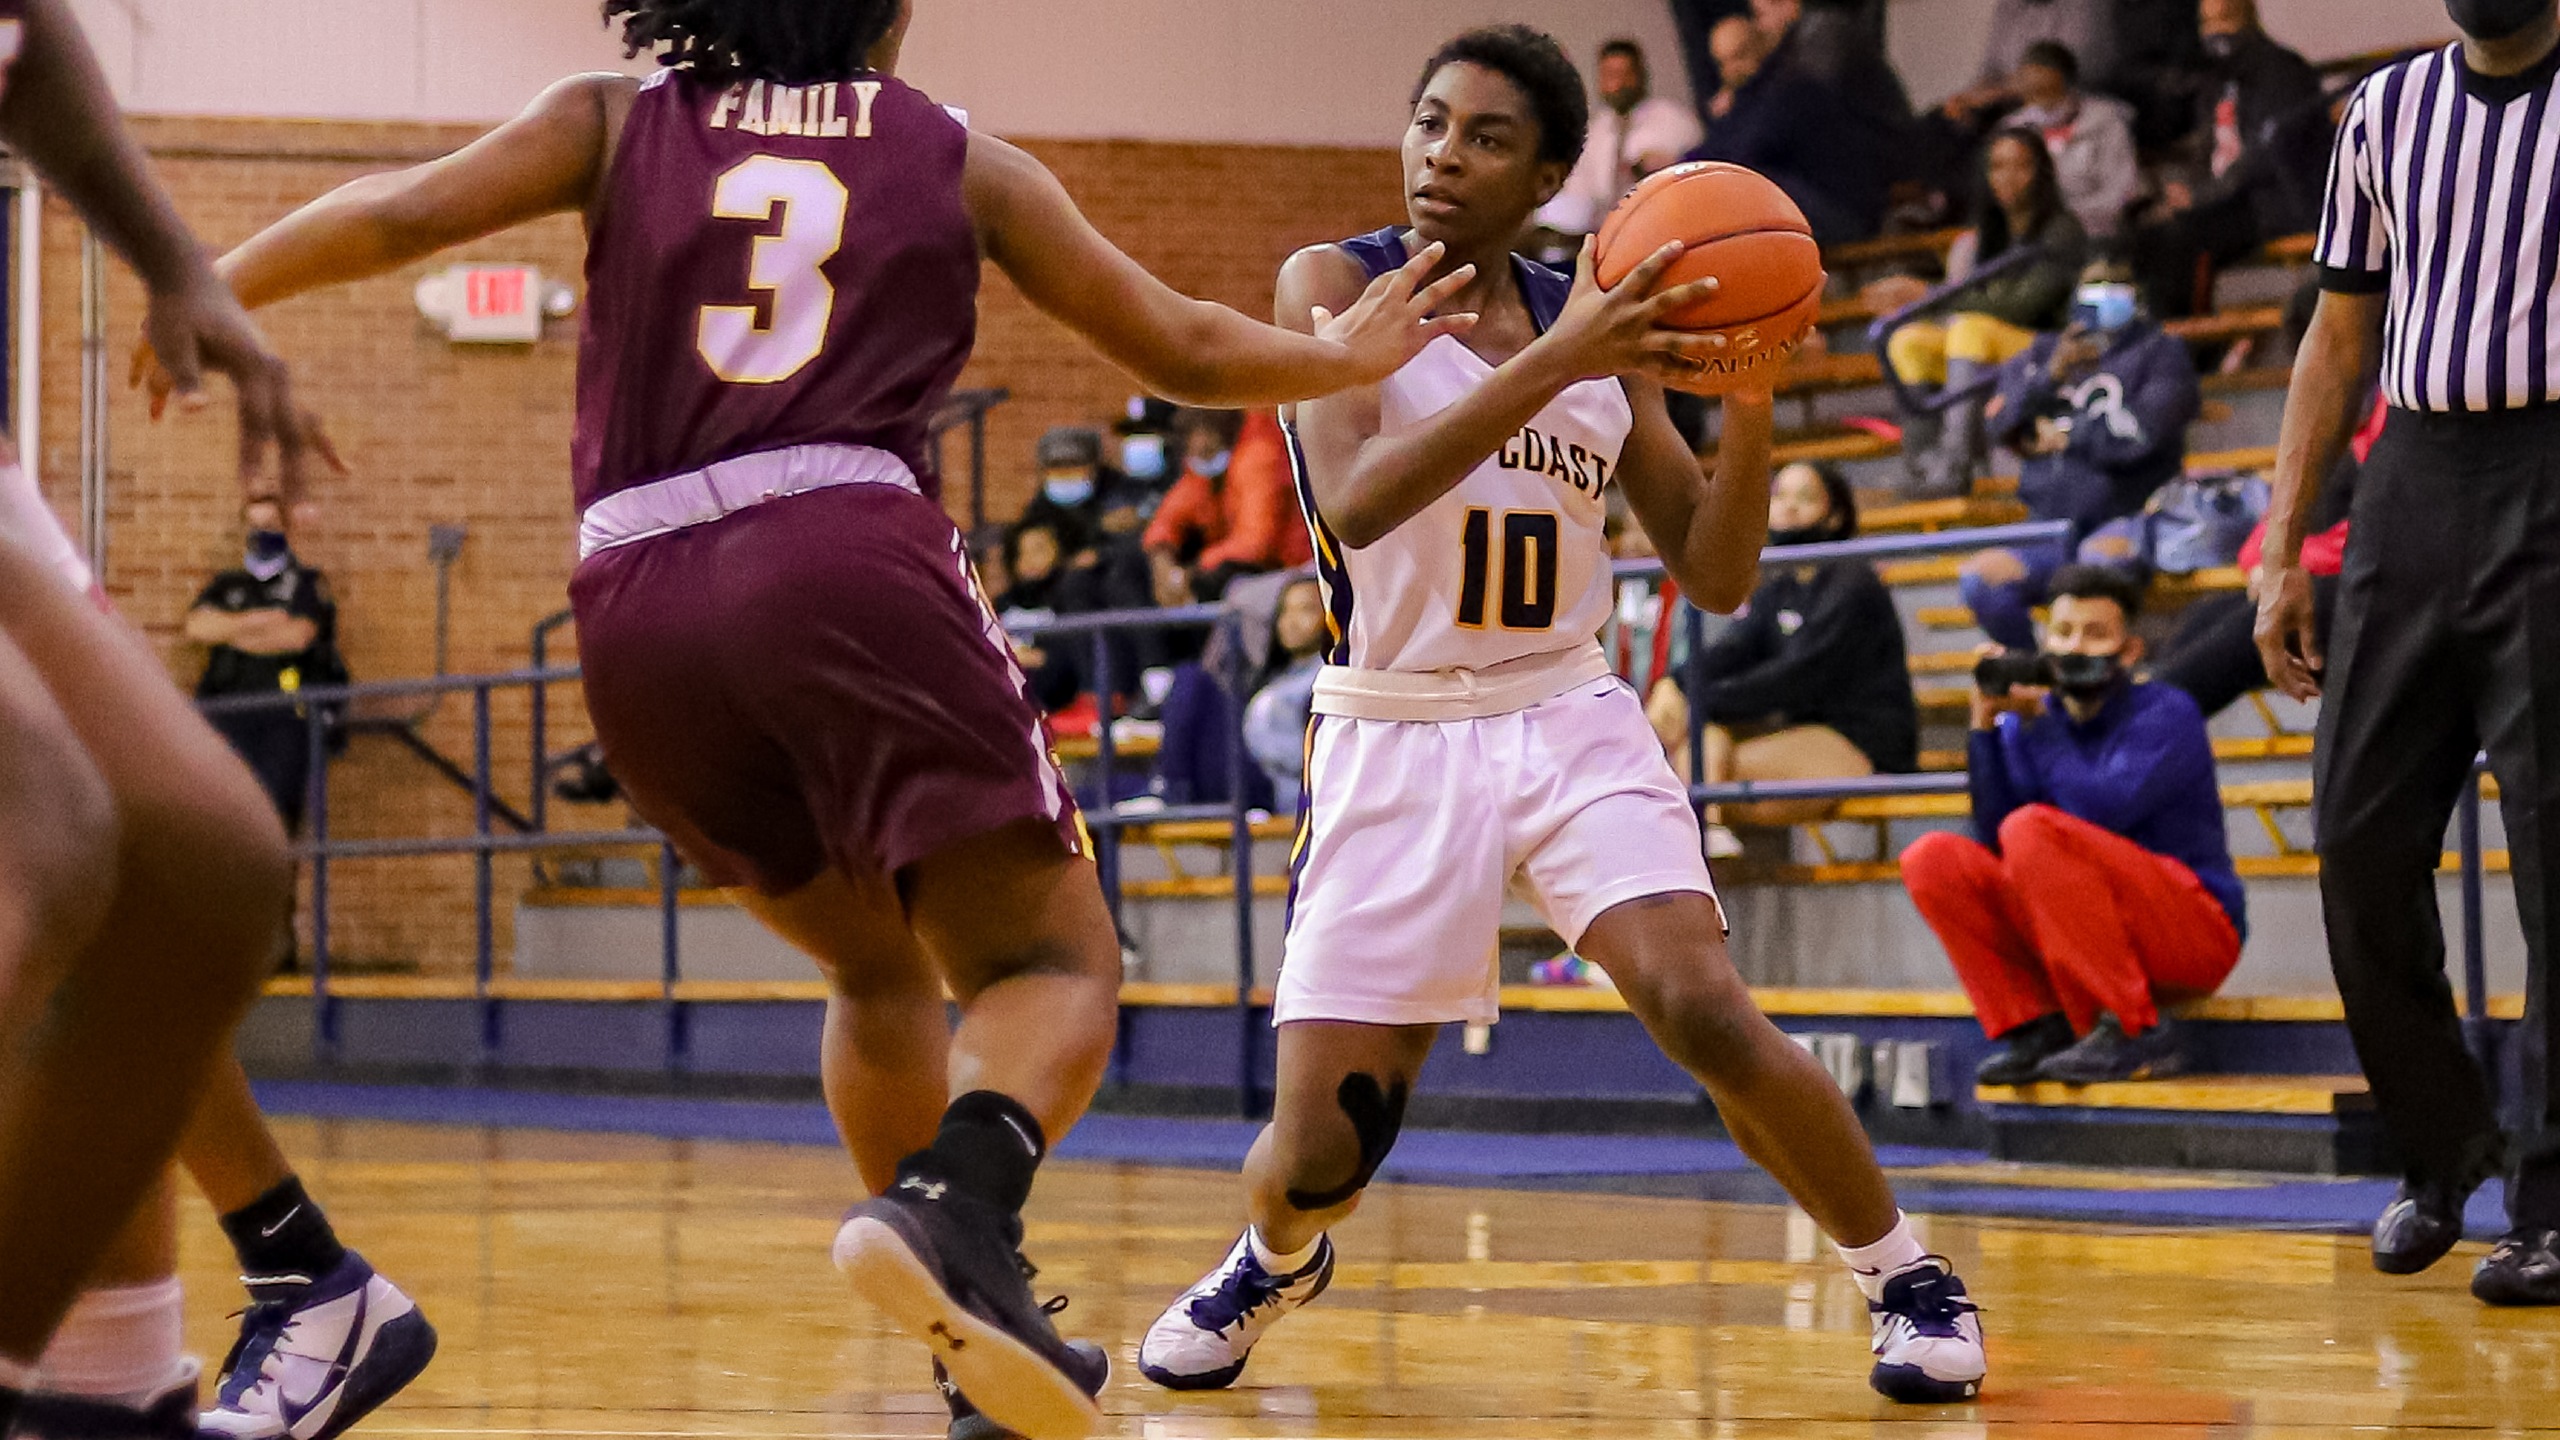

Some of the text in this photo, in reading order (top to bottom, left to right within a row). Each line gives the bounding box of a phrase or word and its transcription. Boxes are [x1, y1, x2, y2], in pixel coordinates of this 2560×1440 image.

[710, 79, 883, 138] FAMILY
[697, 154, 849, 384] 3
[1499, 426, 1608, 501] COAST
[1455, 506, 1559, 633] 10
